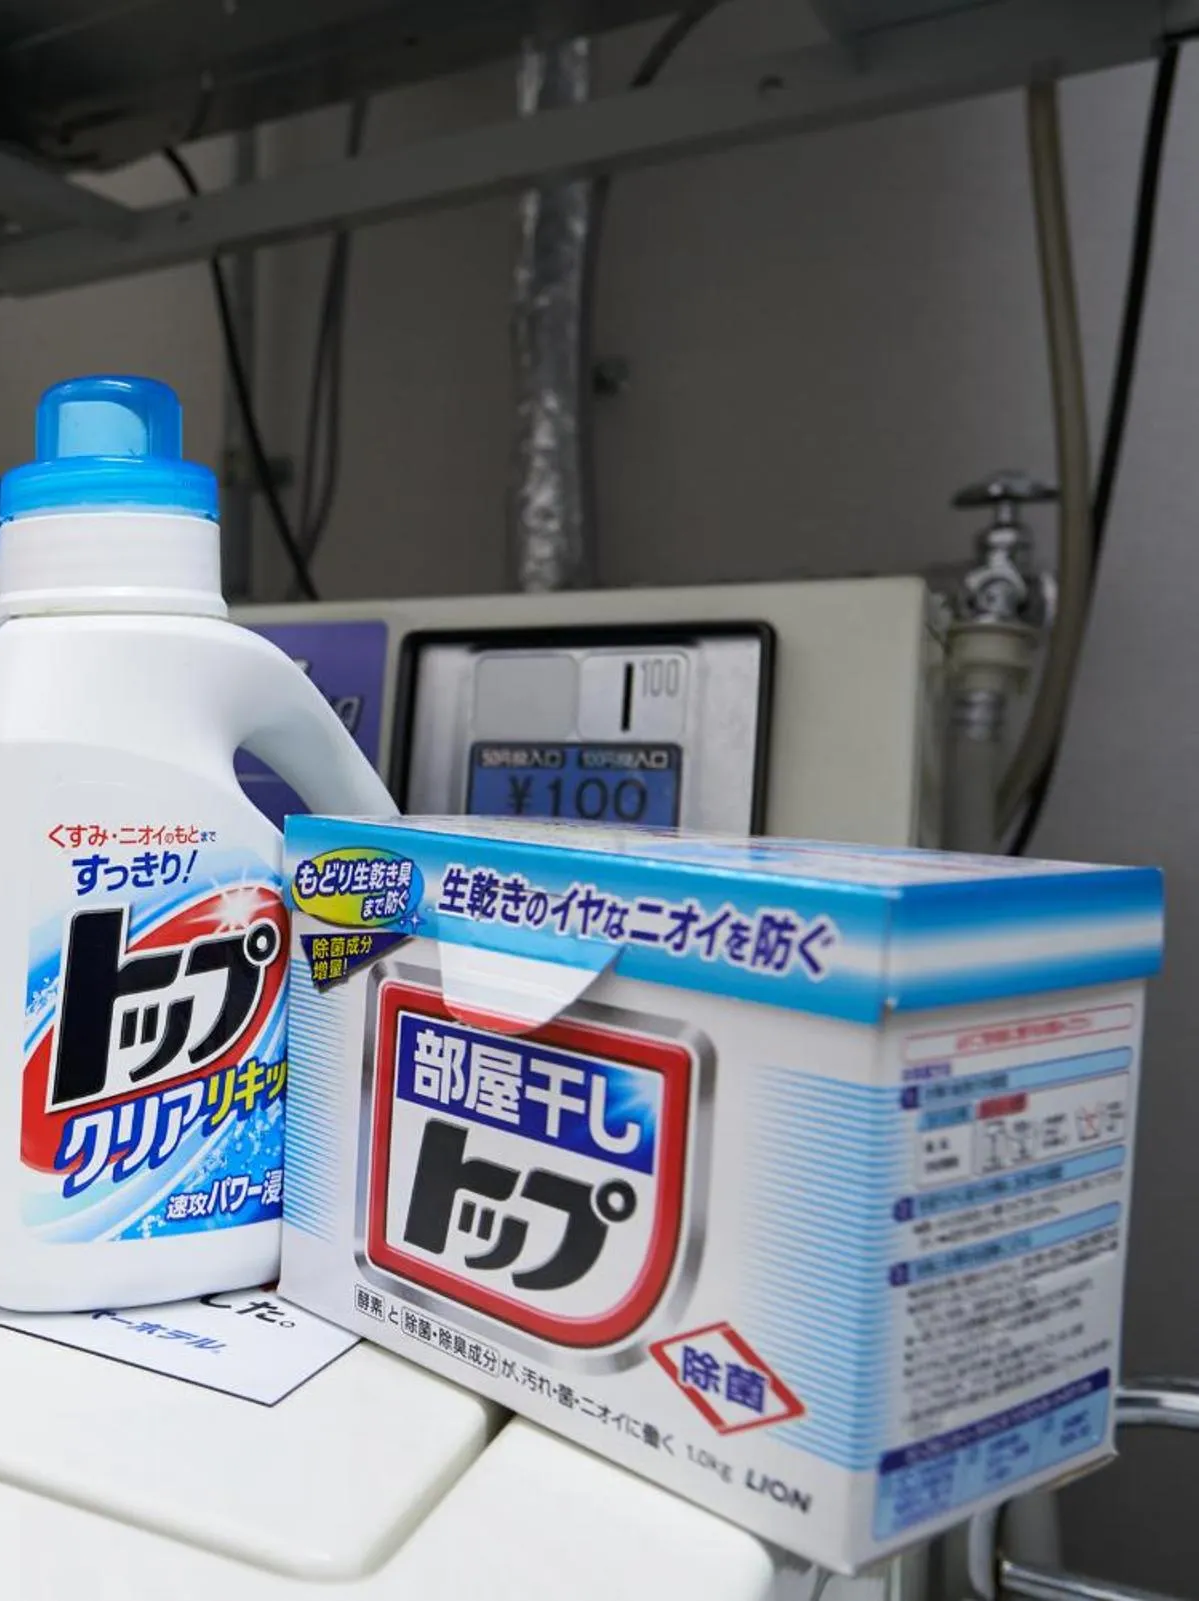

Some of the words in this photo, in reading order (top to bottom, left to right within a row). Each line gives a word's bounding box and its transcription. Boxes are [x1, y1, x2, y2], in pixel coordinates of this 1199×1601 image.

[641, 658, 680, 697] 100
[312, 935, 373, 959] 除菌成分
[438, 868, 836, 975] 生乾きのイヤなニオイを防ぐ
[51, 907, 278, 1106] トップ
[413, 1028, 642, 1155] 部屋干し
[402, 1116, 638, 1292] トップ
[91, 1309, 227, 1351] ーホテル
[680, 1344, 767, 1415] 除菌
[744, 1467, 813, 1515] LION
